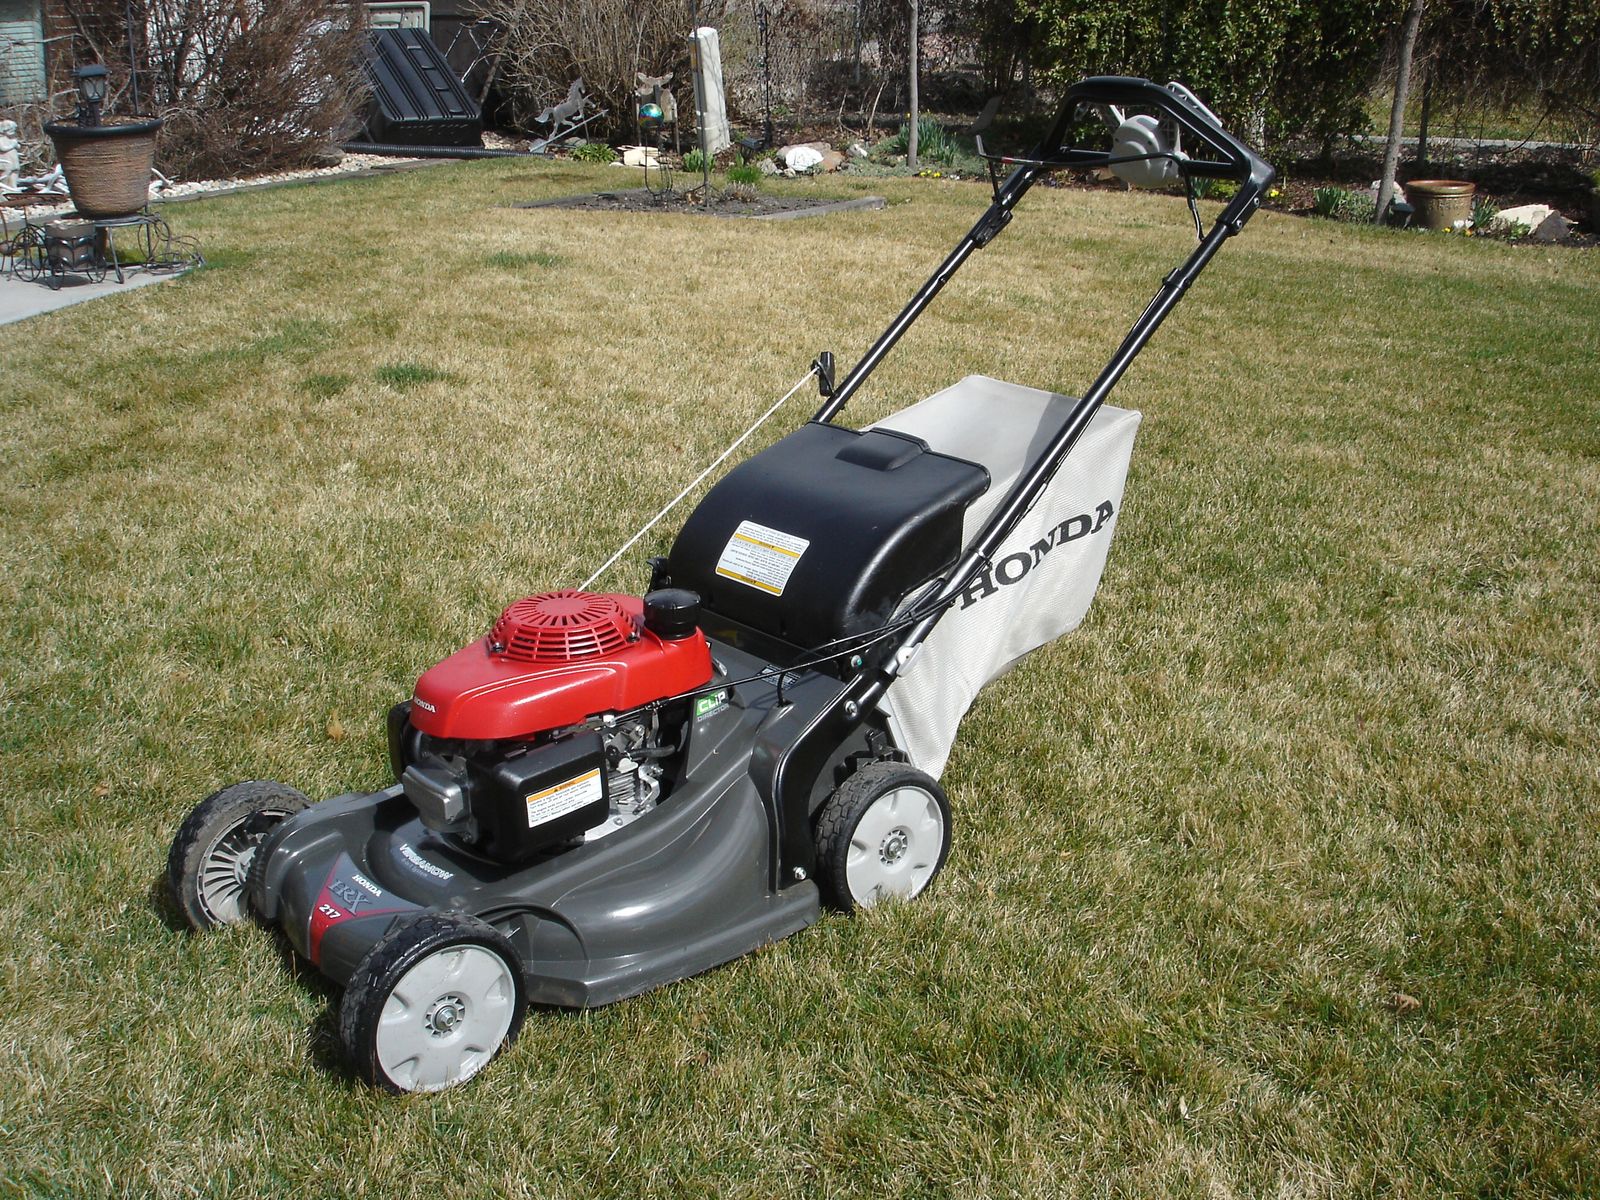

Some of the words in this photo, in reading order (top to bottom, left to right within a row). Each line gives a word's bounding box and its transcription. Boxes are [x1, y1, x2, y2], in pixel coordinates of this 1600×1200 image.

[961, 499, 1114, 610] HONDA
[697, 703, 730, 722] DIRECTOR
[351, 874, 382, 897] HONDA
[327, 879, 372, 916] HRX
[318, 903, 342, 919] 217
